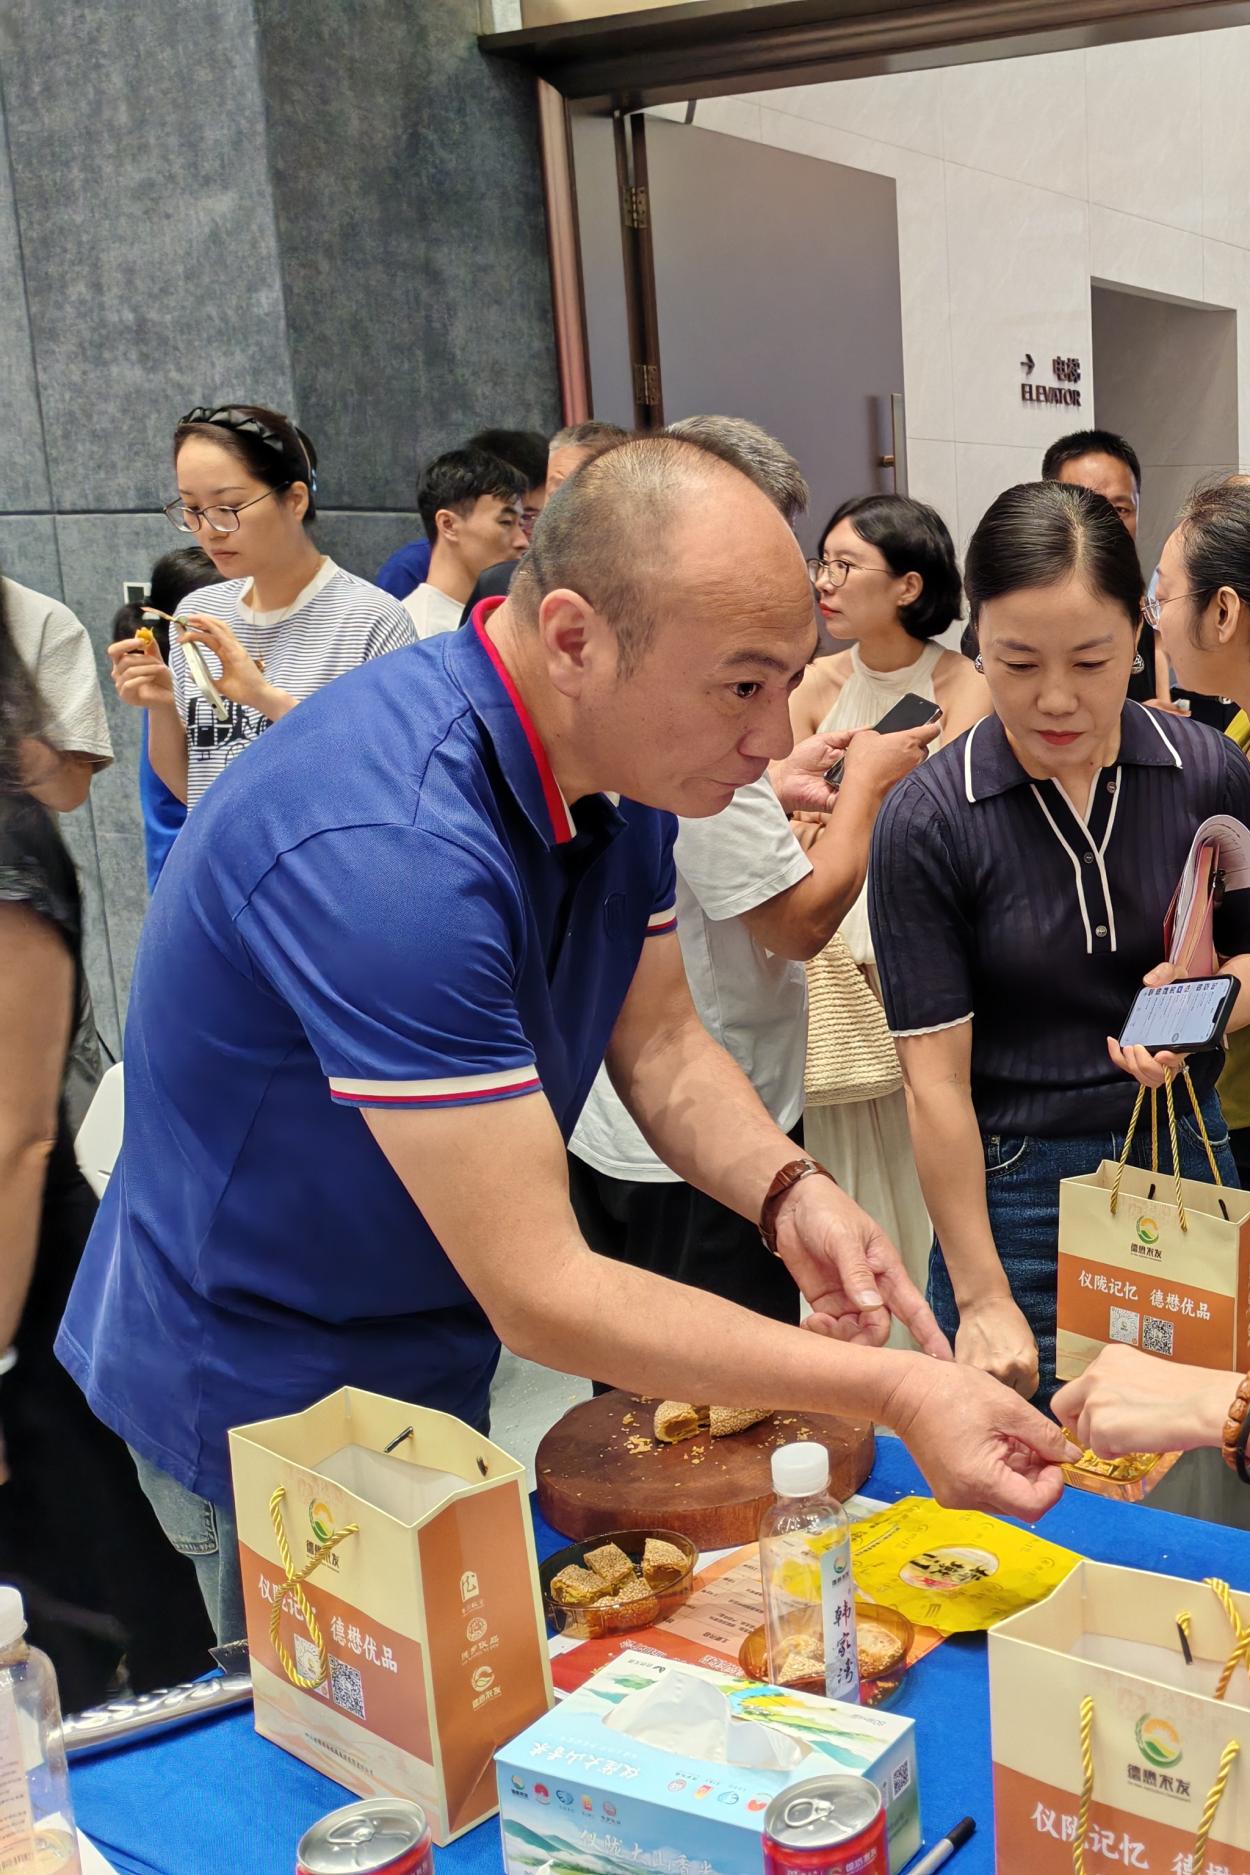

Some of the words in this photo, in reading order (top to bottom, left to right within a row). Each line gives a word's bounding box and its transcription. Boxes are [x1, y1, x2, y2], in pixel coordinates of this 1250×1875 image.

[1052, 355, 1082, 383] 电梯
[1020, 383, 1082, 407] ELEVATOR
[1078, 1270, 1139, 1301] 仪陇记忆
[1149, 1289, 1211, 1321] 德懋优品
[330, 1615, 398, 1674] 德懋优品
